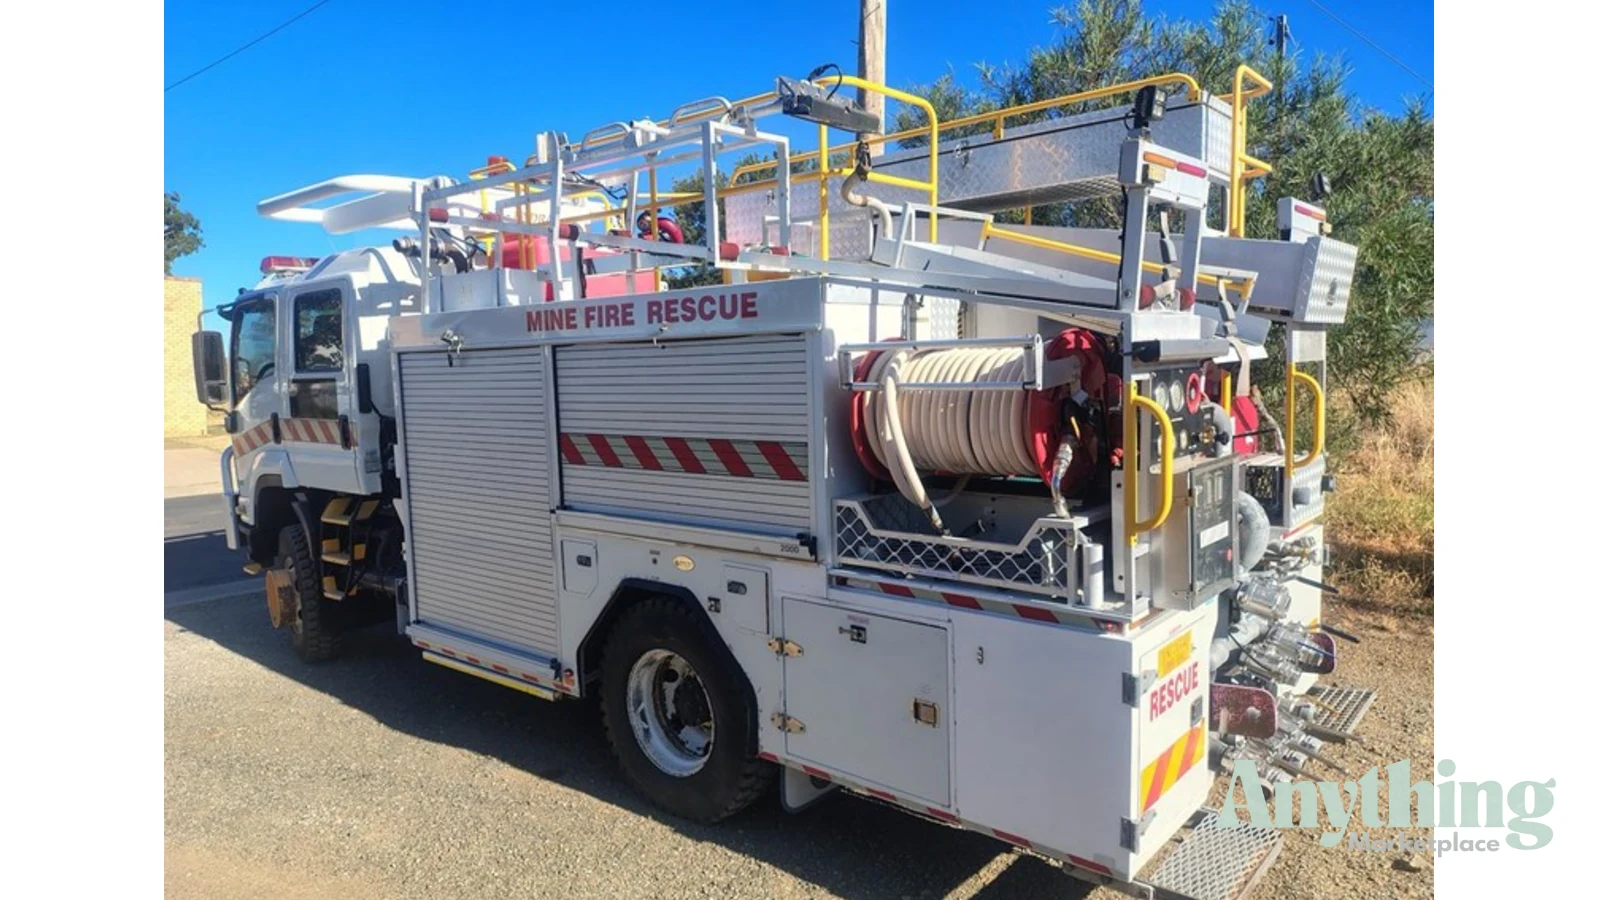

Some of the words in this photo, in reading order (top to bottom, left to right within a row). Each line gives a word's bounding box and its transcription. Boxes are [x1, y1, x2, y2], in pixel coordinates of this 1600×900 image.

[526, 308, 578, 332] MINE
[584, 302, 635, 329] FIRE
[647, 291, 759, 324] RESCUE
[1150, 661, 1199, 722] RESCUE
